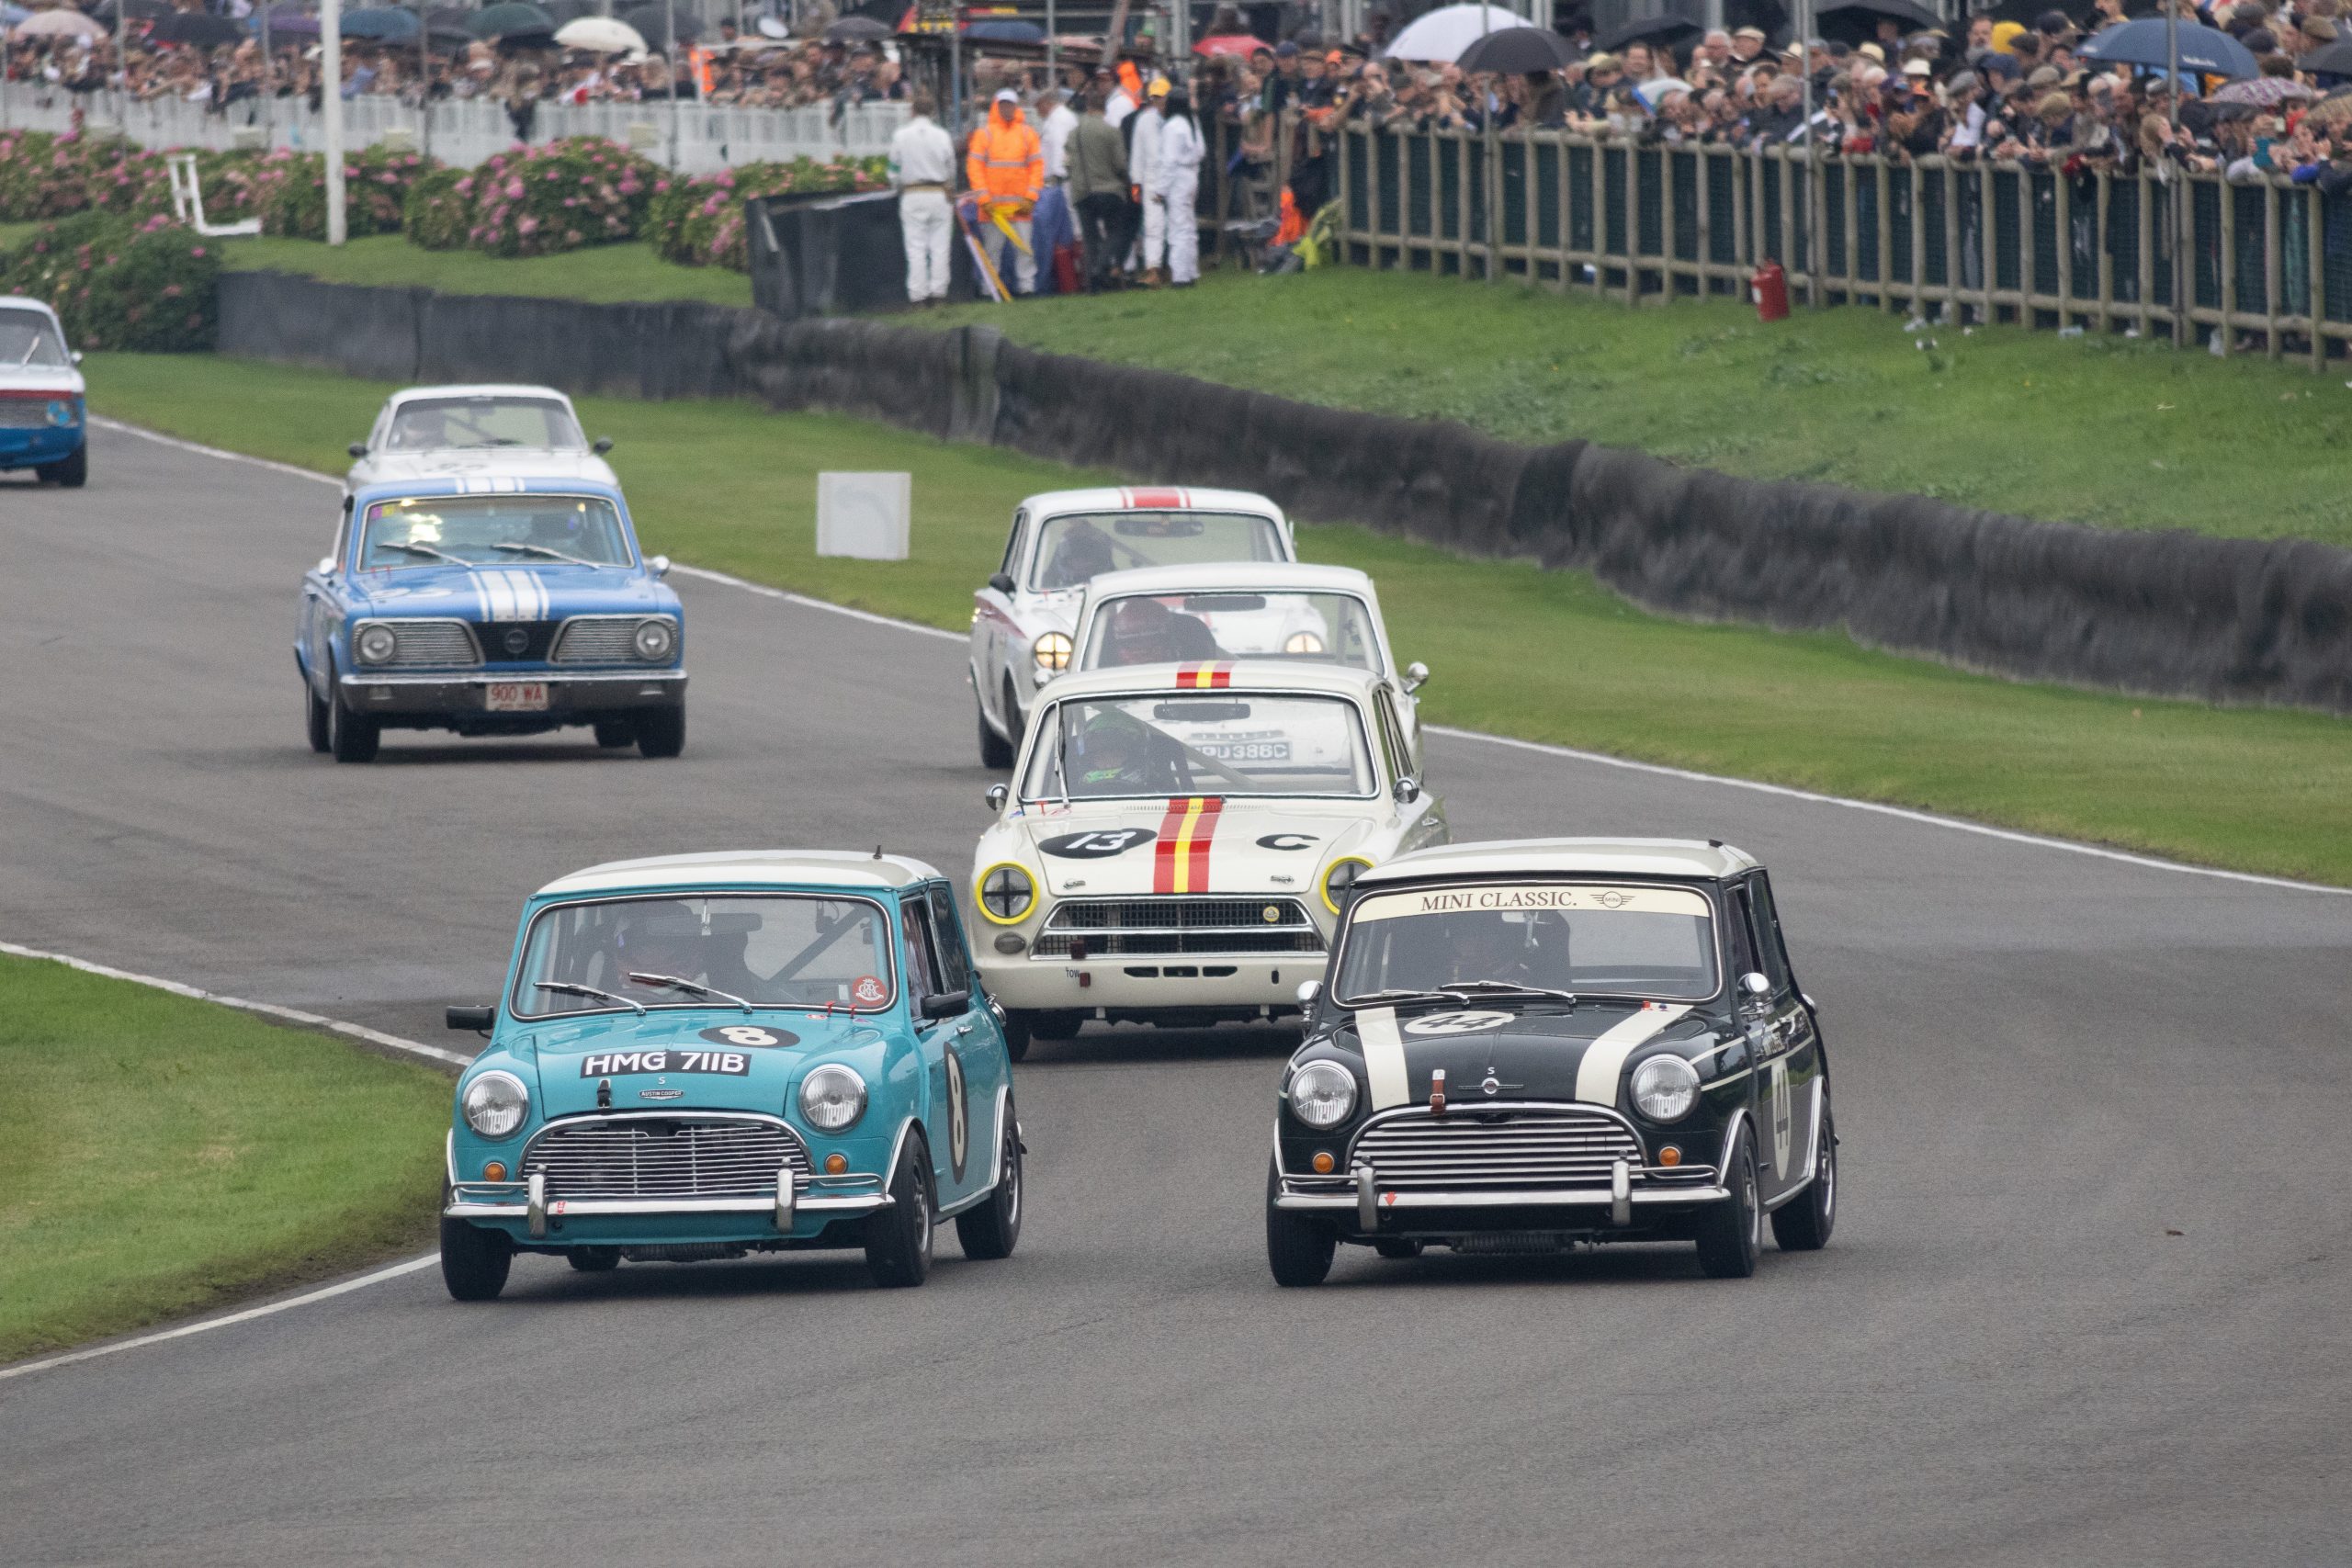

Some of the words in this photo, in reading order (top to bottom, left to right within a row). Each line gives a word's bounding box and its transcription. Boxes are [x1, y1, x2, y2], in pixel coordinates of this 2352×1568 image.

[1066, 831, 1137, 850] 13
[1255, 833, 1320, 851] C
[1420, 893, 1474, 910] MINI
[1480, 891, 1577, 907] CLASSIC.
[1418, 1014, 1505, 1028] 44
[719, 1026, 778, 1045] 8
[584, 1052, 665, 1076] HMG
[680, 1052, 744, 1073] 711B
[1487, 1066, 1496, 1075] S
[658, 1077, 666, 1085] S
[948, 1053, 964, 1168] 8
